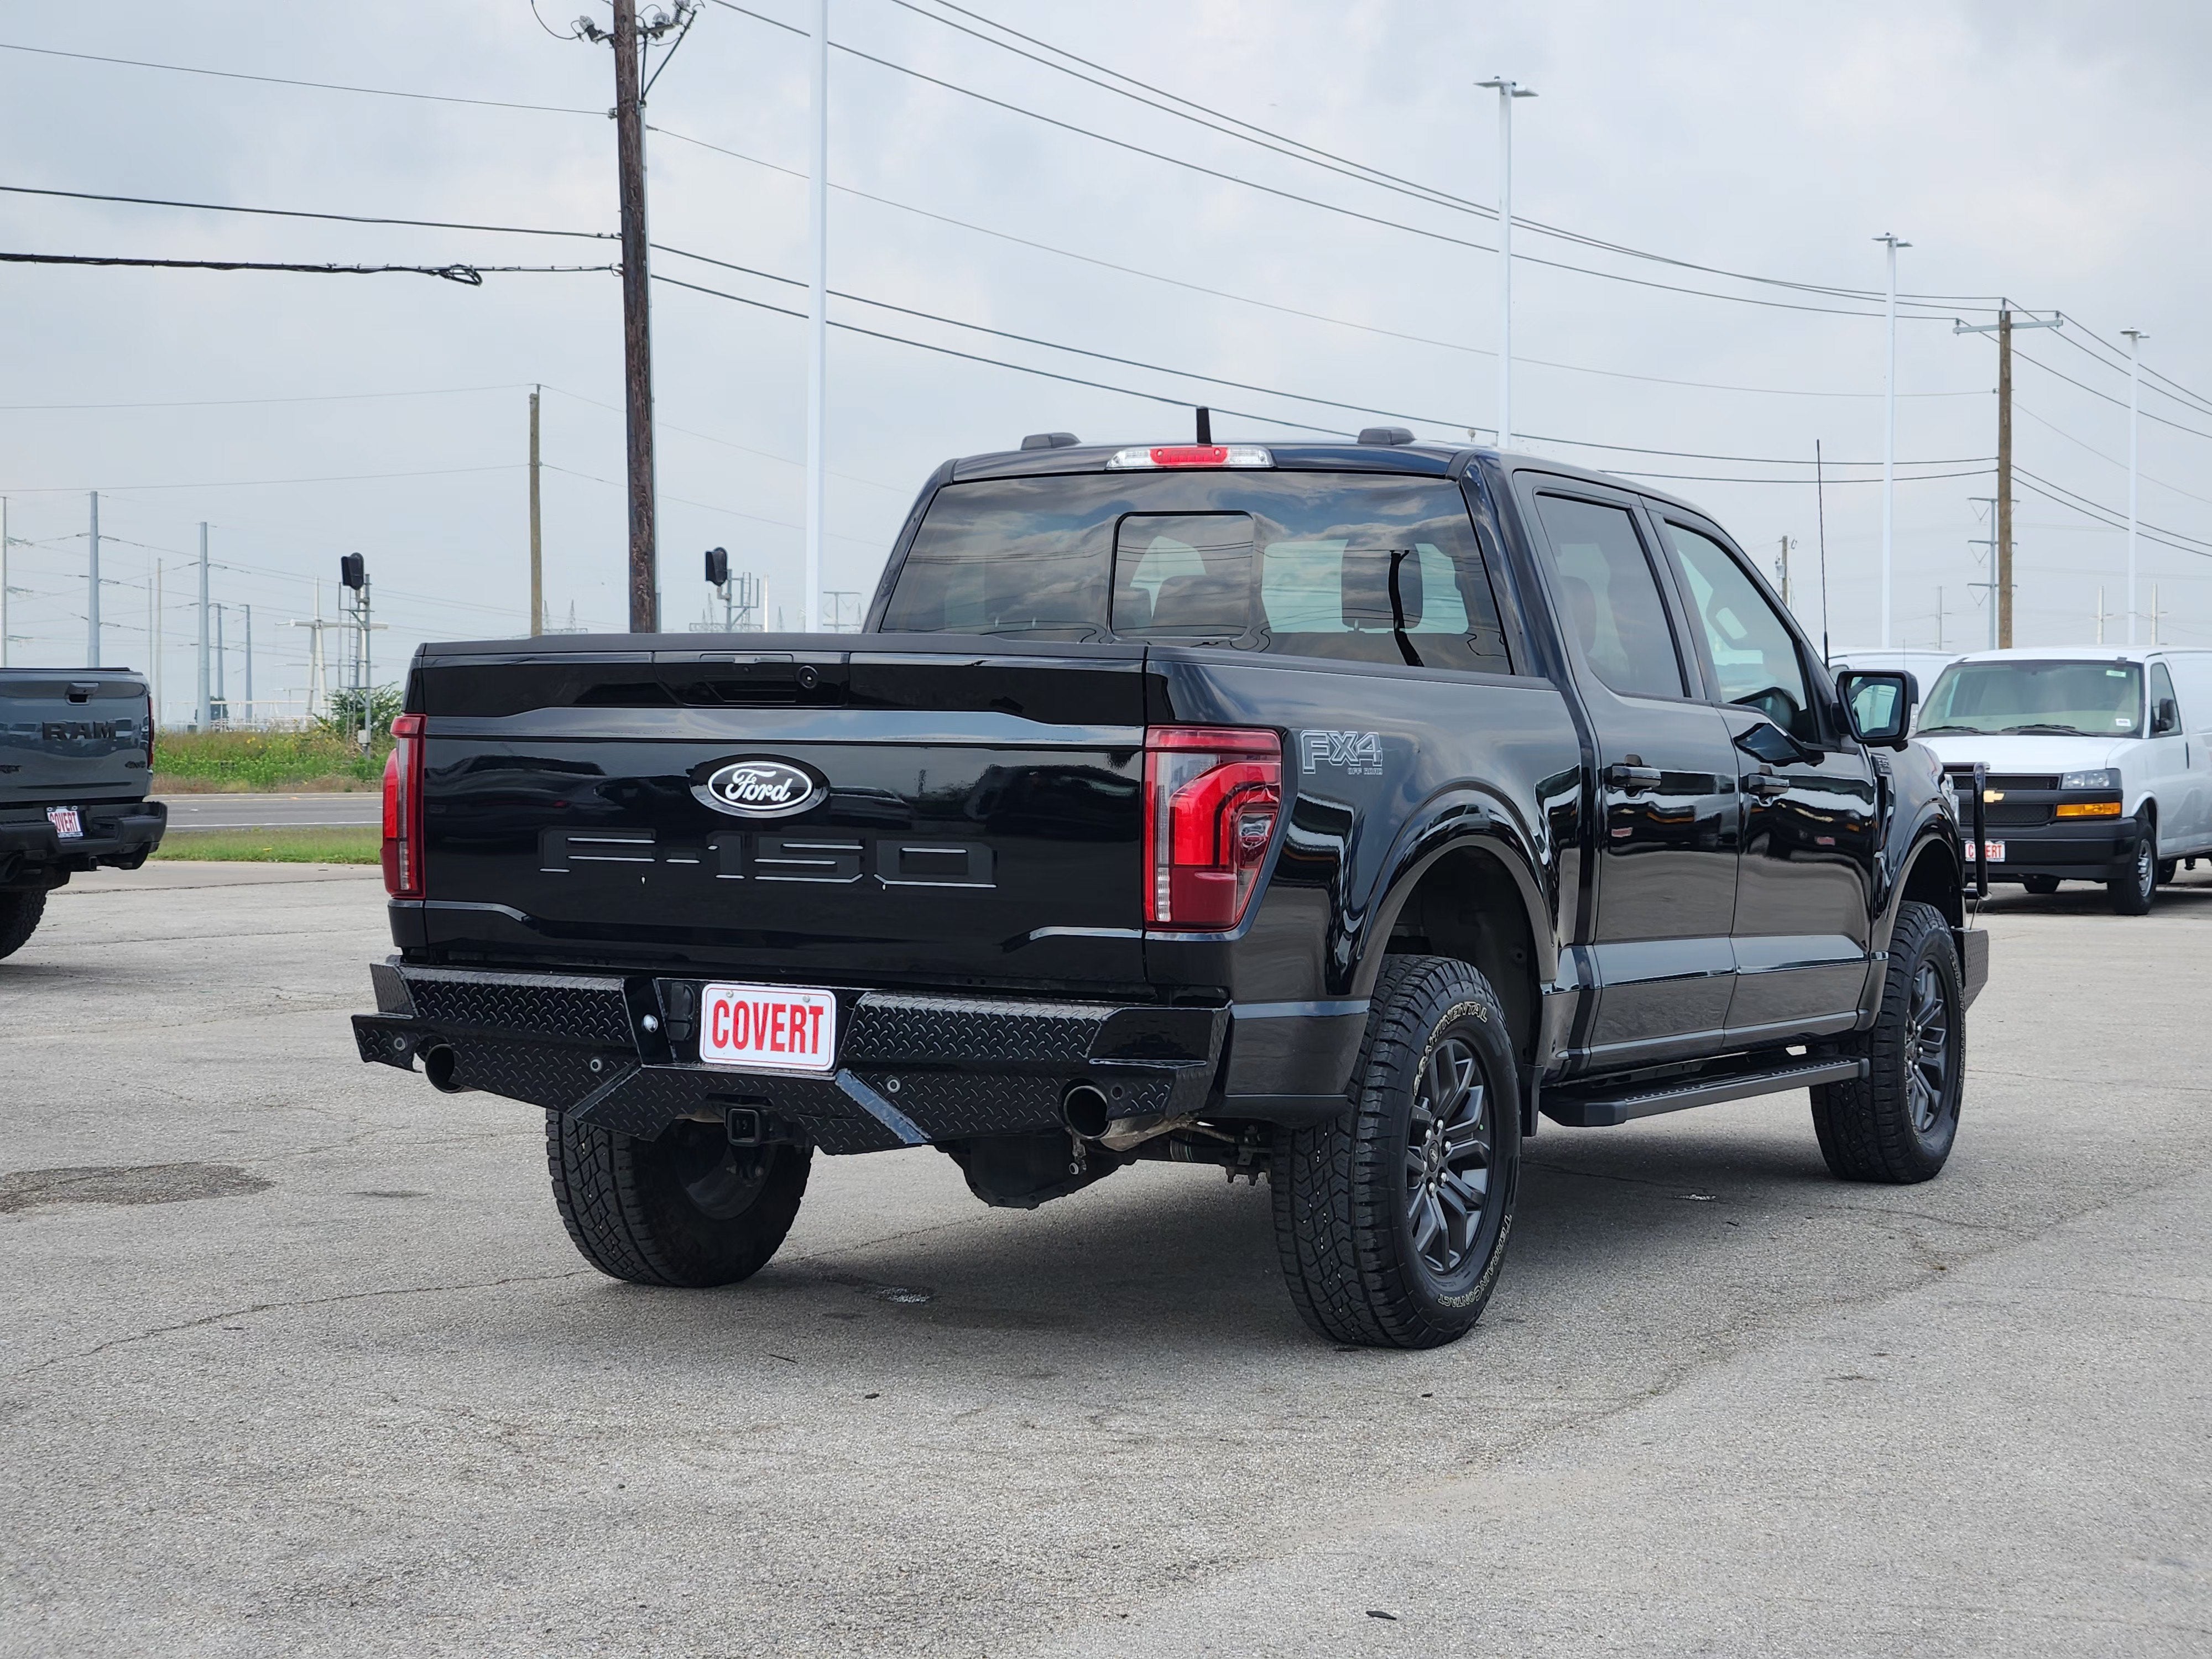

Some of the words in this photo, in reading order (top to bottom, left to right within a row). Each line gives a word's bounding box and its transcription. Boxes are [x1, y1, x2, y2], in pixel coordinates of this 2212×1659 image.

[43, 721, 116, 740] RAM
[1300, 730, 1383, 774] FX4
[724, 768, 791, 802] Ford
[538, 826, 997, 888] F-150
[1968, 844, 2002, 858] CERT
[712, 999, 823, 1054] COVERT
[1413, 1001, 1488, 1097] CONTINENTAL
